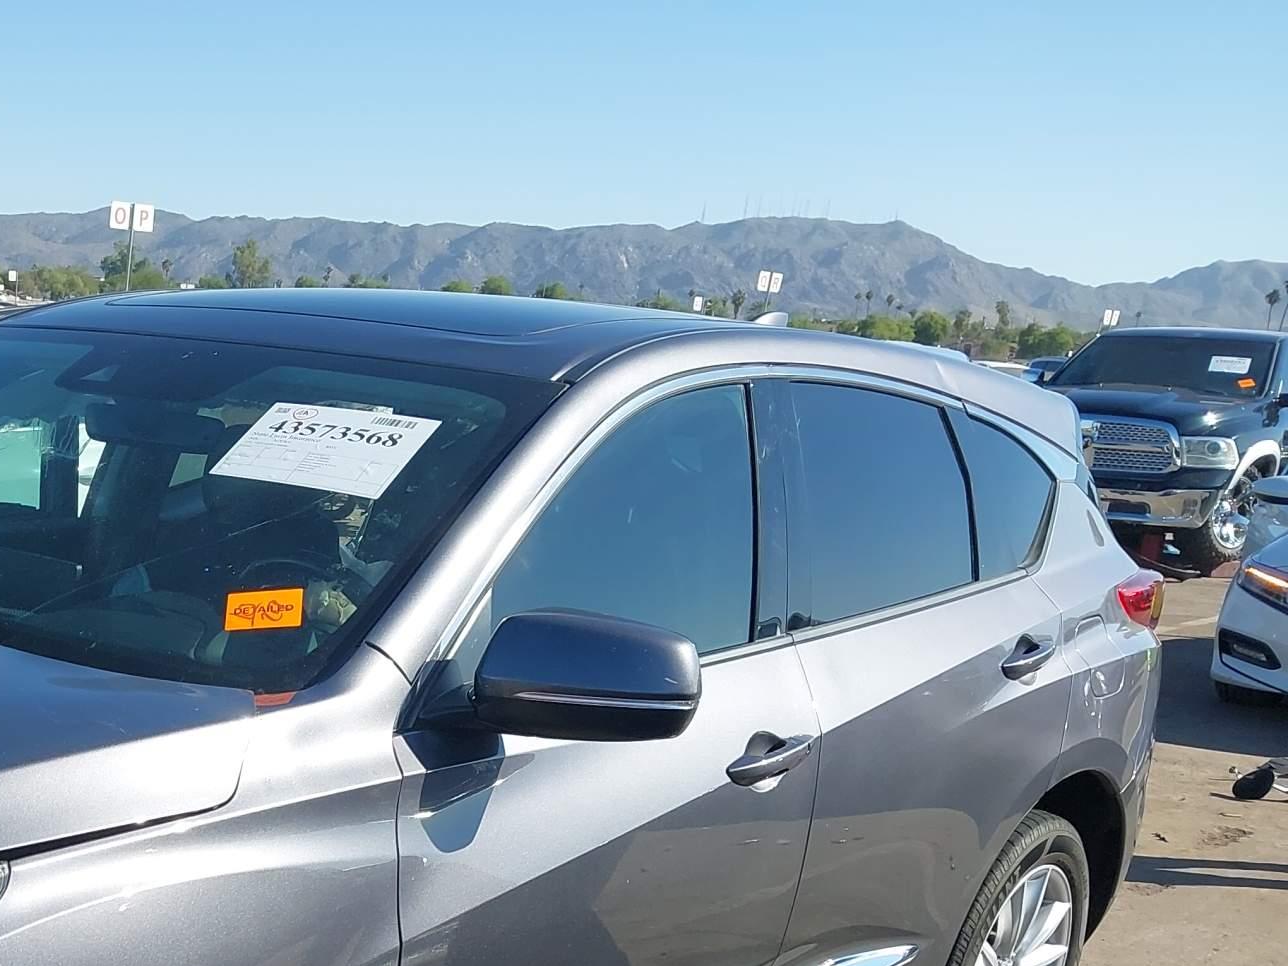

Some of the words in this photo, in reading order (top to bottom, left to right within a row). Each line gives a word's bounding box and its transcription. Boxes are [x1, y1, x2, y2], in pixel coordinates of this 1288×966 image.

[139, 210, 149, 227] P
[268, 420, 403, 447] 43573568
[233, 603, 294, 616] DETAILED
